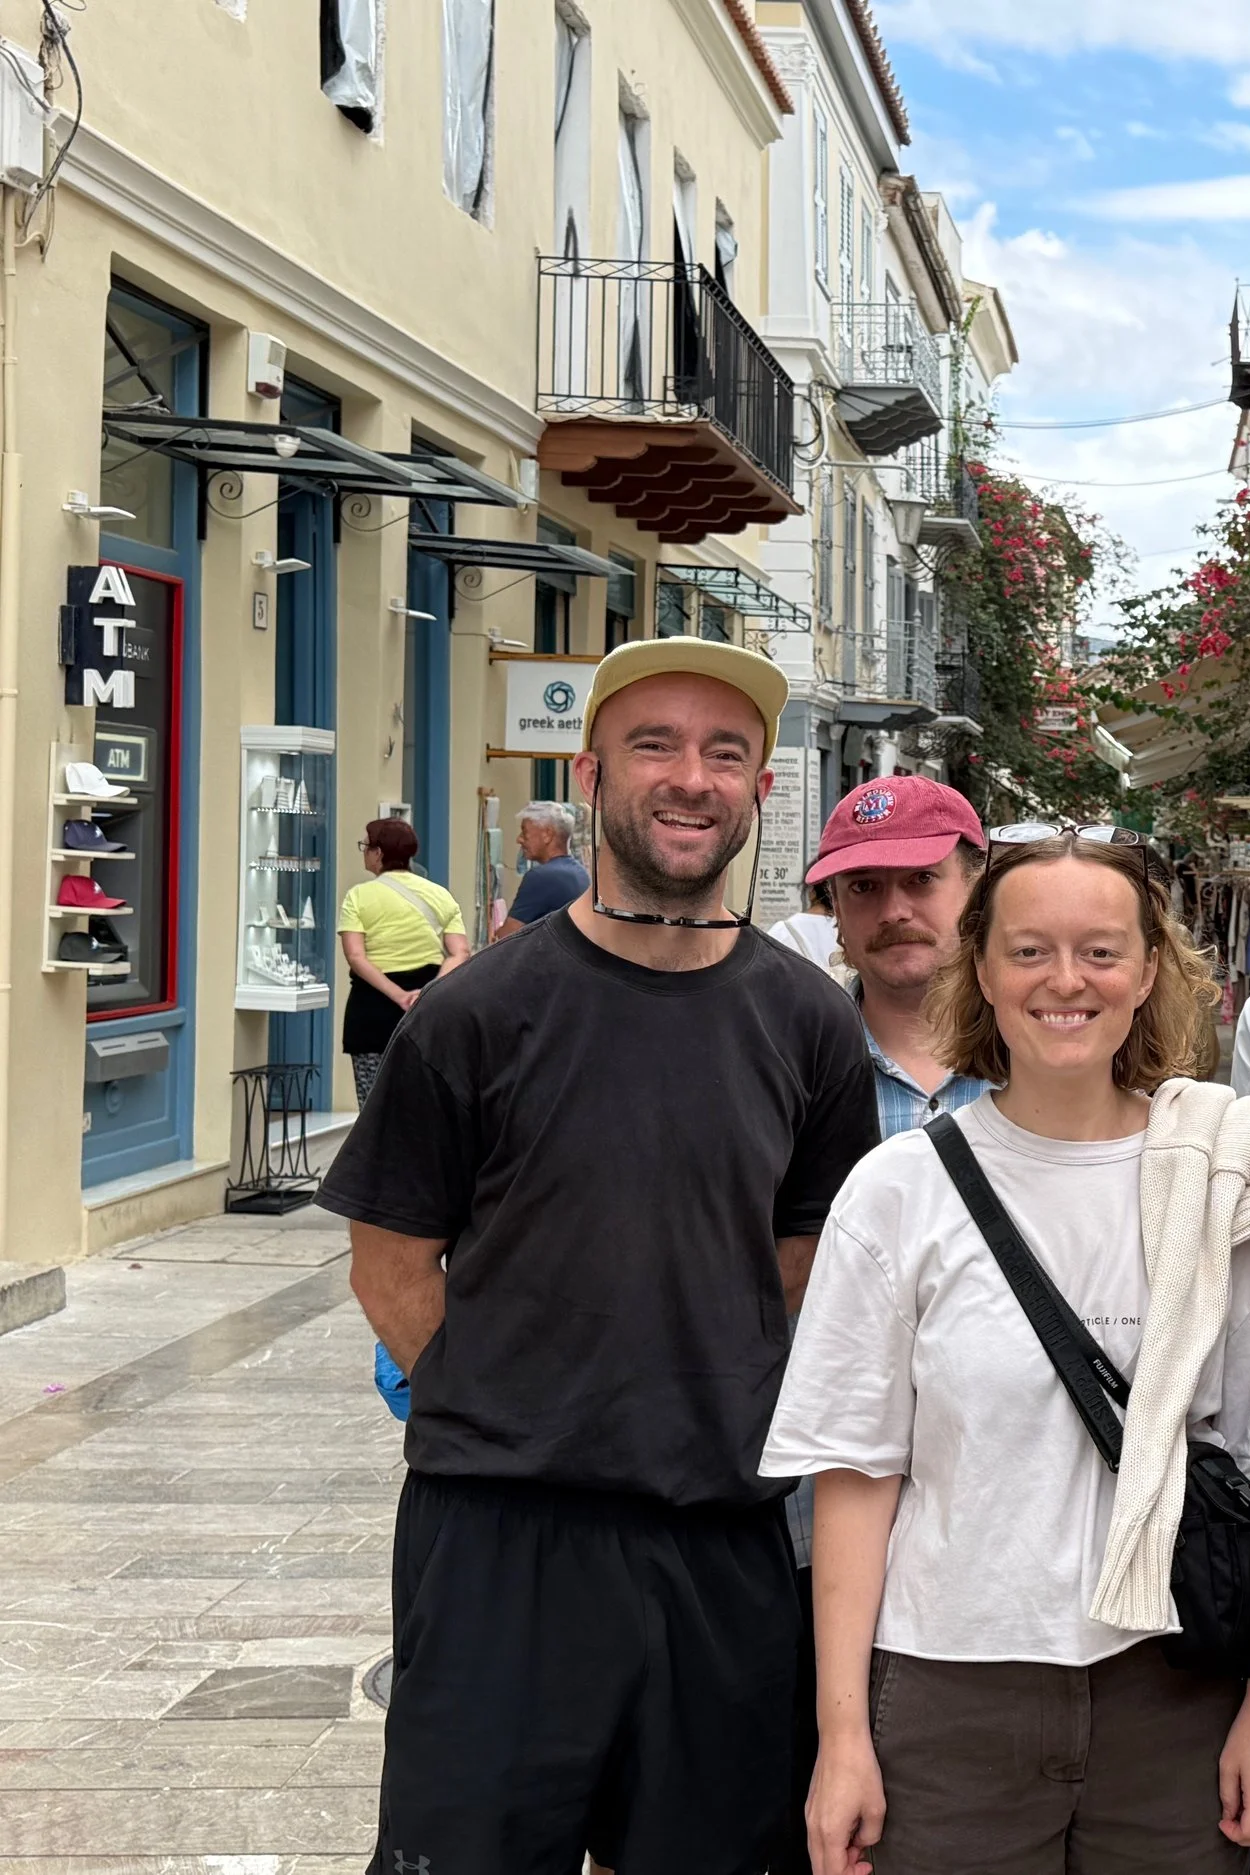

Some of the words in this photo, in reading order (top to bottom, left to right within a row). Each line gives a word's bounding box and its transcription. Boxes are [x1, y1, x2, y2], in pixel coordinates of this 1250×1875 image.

[83, 565, 136, 708] ATM
[519, 716, 555, 731] greek
[107, 748, 131, 769] ATM
[1121, 1317, 1141, 1326] ONE
[1092, 1358, 1119, 1389] FUJIFILM
